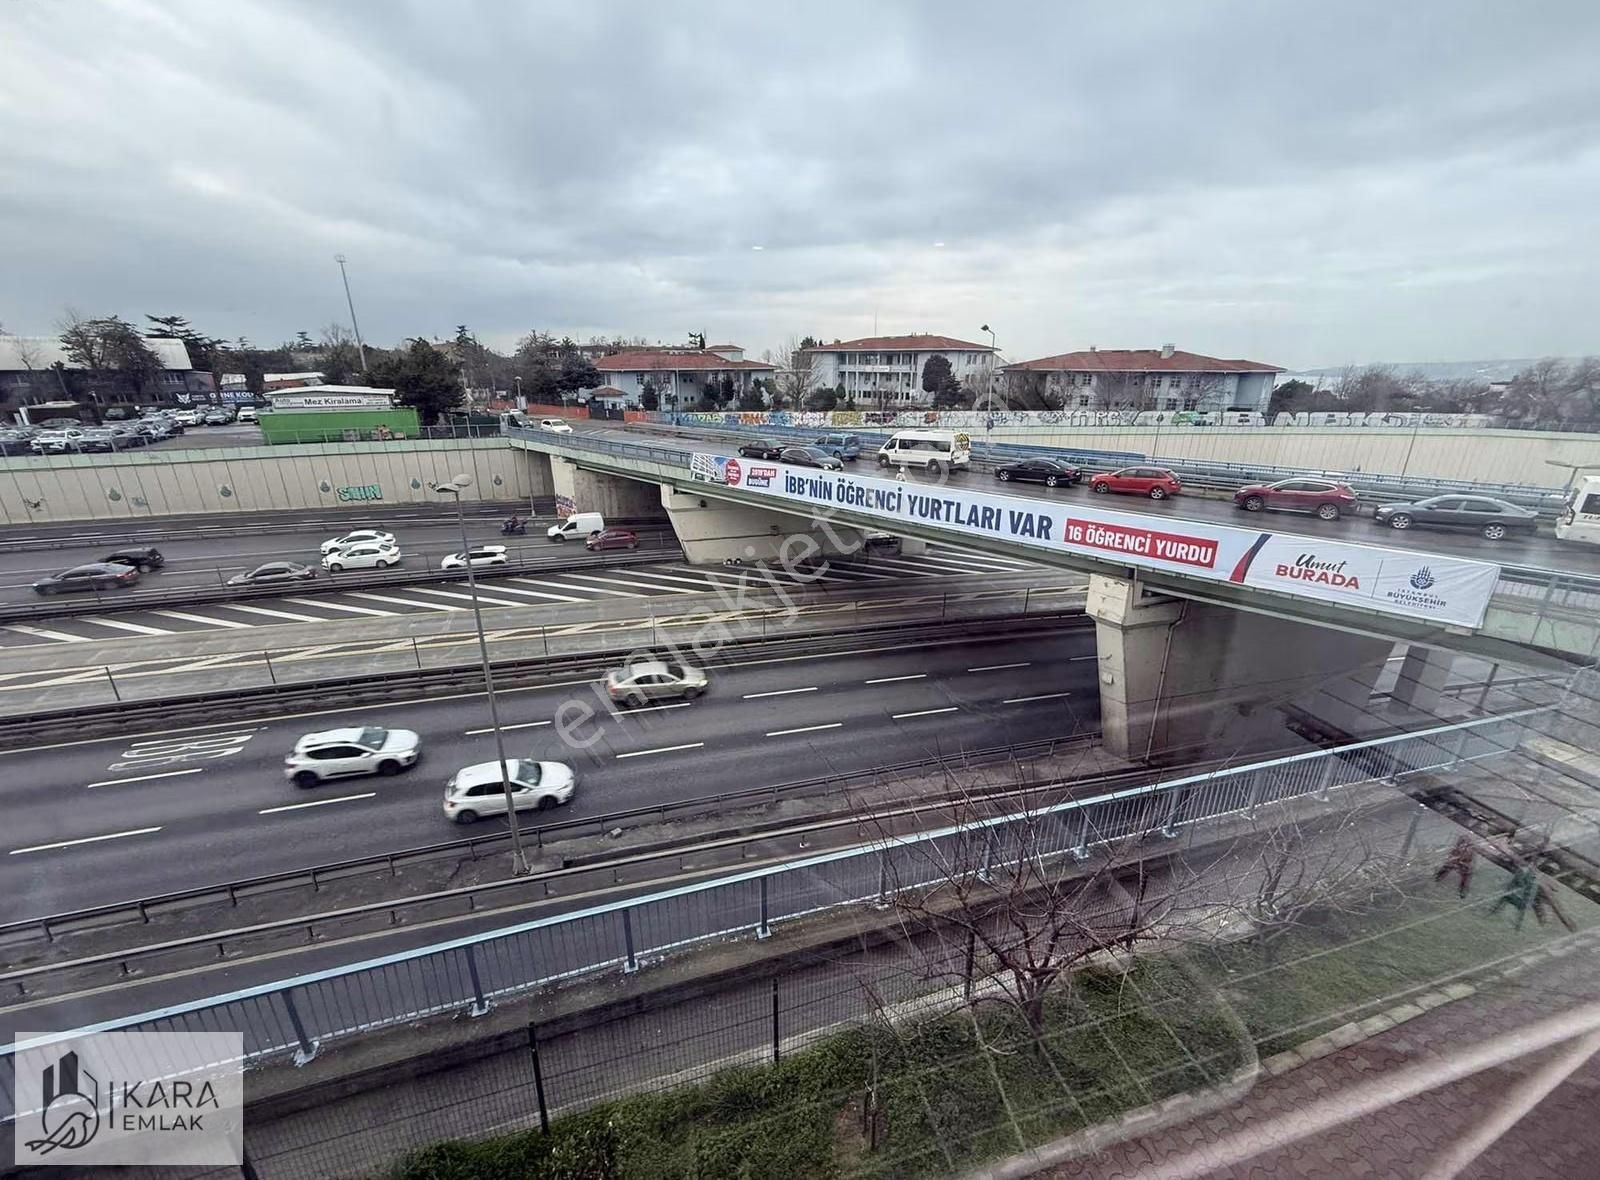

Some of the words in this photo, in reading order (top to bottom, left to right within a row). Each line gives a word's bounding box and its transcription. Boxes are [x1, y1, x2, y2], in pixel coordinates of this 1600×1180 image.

[785, 471, 833, 501] İBB'NİN
[836, 478, 902, 512] ÖĞRENCİ
[907, 494, 1001, 531] YURTLARI
[1009, 511, 1052, 540] VAR
[1068, 525, 1082, 540] 16
[1086, 525, 1151, 554] ÖĞRENCİ
[1155, 539, 1213, 563] YURDU
[1276, 564, 1360, 590] BURADA
[1295, 553, 1347, 573] Umut
